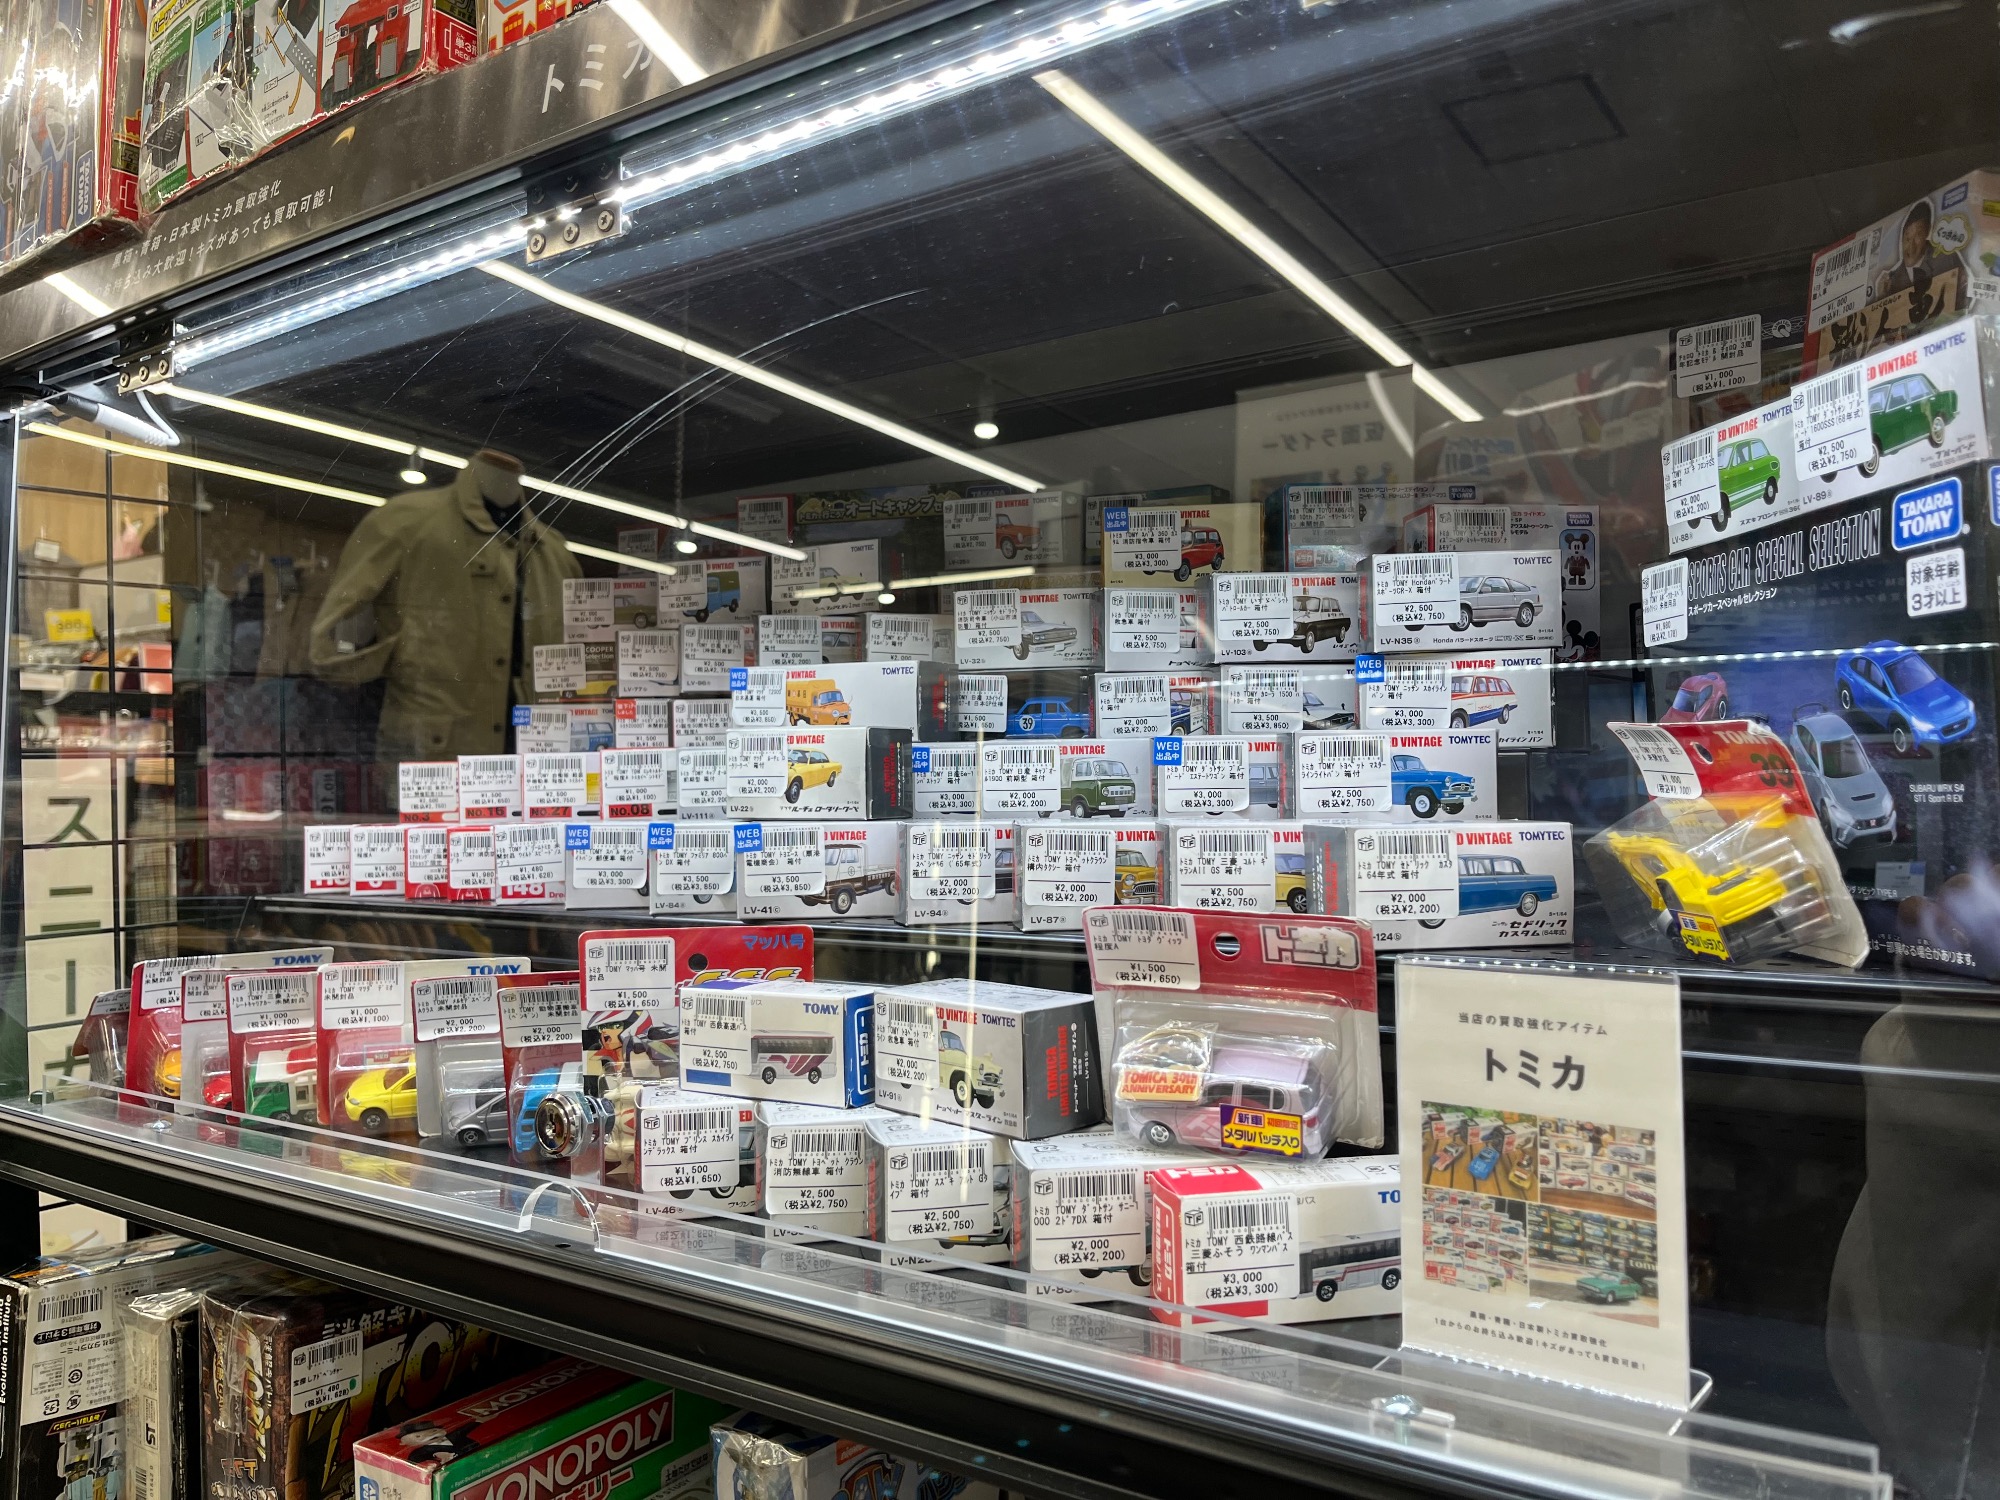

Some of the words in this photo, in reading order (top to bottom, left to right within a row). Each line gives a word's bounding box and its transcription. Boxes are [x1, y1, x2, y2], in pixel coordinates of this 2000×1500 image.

[1878, 351, 1918, 378] VINTAGE
[1924, 332, 1967, 356] TOMYTEC
[1900, 490, 1952, 516] TAKARA
[1107, 512, 1126, 520] WEB
[1180, 510, 1210, 518] VINTAGE
[1900, 508, 1952, 538] TOMY
[851, 544, 874, 552] TOMYTEC
[1688, 554, 1726, 600] SPORTS
[1728, 547, 1751, 590] CAR
[1755, 531, 1804, 586] SPECIAL
[1809, 508, 1881, 572] SELECTION
[1513, 557, 1552, 565] TOMYTEC
[1910, 562, 1960, 586] 対象年齢
[1302, 577, 1336, 586] VINTAGE
[1911, 586, 1961, 612] 3才以上
[1404, 604, 1433, 612] ¥2,500
[1392, 612, 1445, 623] (税込¥2,750)
[1134, 634, 1158, 642] ¥2,500
[1358, 660, 1381, 669] WEB
[1457, 660, 1496, 669] VINTAGE
[1502, 658, 1542, 667] TOMYTEC
[791, 670, 816, 678] VINTAGE
[882, 667, 914, 675] TOMYTEC
[1022, 717, 1033, 730] 39
[1381, 718, 1435, 726] (税込¥3,300)
[797, 735, 825, 744] VINTAGE
[1401, 736, 1442, 747] VINTAGE
[1449, 736, 1491, 744] TOMYTEC
[1070, 745, 1105, 754] VINTAGE
[1156, 742, 1180, 750] WEB
[1156, 752, 1180, 761] 出品中
[1750, 753, 1794, 788] 39
[1331, 789, 1362, 797] ¥2,500
[1909, 784, 1936, 793] SUBARU
[1193, 790, 1222, 798] ¥3,000
[998, 800, 1046, 808] (税込¥2,200)
[1181, 799, 1234, 808] (税込¥3,300)
[1317, 798, 1374, 807] (税込¥2,750)
[610, 804, 650, 816] NO.08
[567, 828, 588, 838] WEB
[651, 827, 673, 837] WEB
[736, 828, 761, 838] WEB
[831, 831, 867, 841] VINTAGE
[1466, 832, 1512, 845] VINTAGE
[1519, 831, 1565, 841] TOMYTEC
[671, 883, 720, 891] (税込¥3,850)
[760, 884, 811, 892] (税込¥3,850)
[939, 879, 968, 887] ¥2,000
[1055, 884, 1086, 892] ¥2,000
[1211, 888, 1244, 896] ¥2,500
[1041, 894, 1098, 903] (税込¥2,200)
[1196, 898, 1258, 907] (税込¥2,750)
[1391, 894, 1426, 903] ¥2,000
[1376, 905, 1440, 915] (税込¥2,200)
[1509, 920, 1566, 928] セドリック
[742, 934, 805, 950] マッハ号
[272, 954, 323, 965] TOMY
[468, 965, 521, 975] TOMY
[1130, 963, 1166, 973] ¥1,500
[1116, 973, 1181, 985] (税込¥1,650)
[617, 990, 647, 999] ¥1,500
[604, 999, 659, 1008] (税込¥1,650)
[803, 1002, 839, 1014] TOMY
[337, 1016, 390, 1024] (税込¥1,100)
[946, 1009, 977, 1024] VINTAGE
[982, 1013, 1016, 1027] TOMYTEC
[1458, 1012, 1608, 1036] 当店の買取強化アイテム
[703, 1049, 728, 1058] ¥2,500
[860, 1032, 871, 1067] トミカ
[692, 1058, 738, 1069] (税込¥2,750)
[896, 1058, 917, 1069] ¥2,000
[1484, 1048, 1585, 1091] トミカ
[1123, 1072, 1168, 1084] TOMICA
[1122, 1084, 1196, 1096] ANNIVERSARY
[1237, 1113, 1262, 1126] 新車
[675, 1165, 708, 1174] ¥1,500
[773, 1167, 820, 1176] 消防無線車
[825, 1167, 843, 1175] 箱付
[1168, 1165, 1239, 1178] トミカ
[660, 1174, 722, 1186] (税込¥1,650)
[800, 1189, 835, 1198] ¥2,500
[784, 1200, 848, 1209] (税込¥2,750)
[925, 1210, 960, 1220] ¥2,500
[908, 1221, 974, 1234] (税込¥2,750)
[1071, 1240, 1110, 1250] ¥2,000
[1186, 1239, 1201, 1248] トミカ
[1207, 1237, 1228, 1246] TOMY
[1234, 1232, 1293, 1244] 西鉄路線バス
[1054, 1251, 1126, 1264] (税込¥2,200)
[1164, 1237, 1173, 1281] トミカ
[1223, 1272, 1262, 1284] ¥3,000
[2, 1294, 12, 1344] Institute
